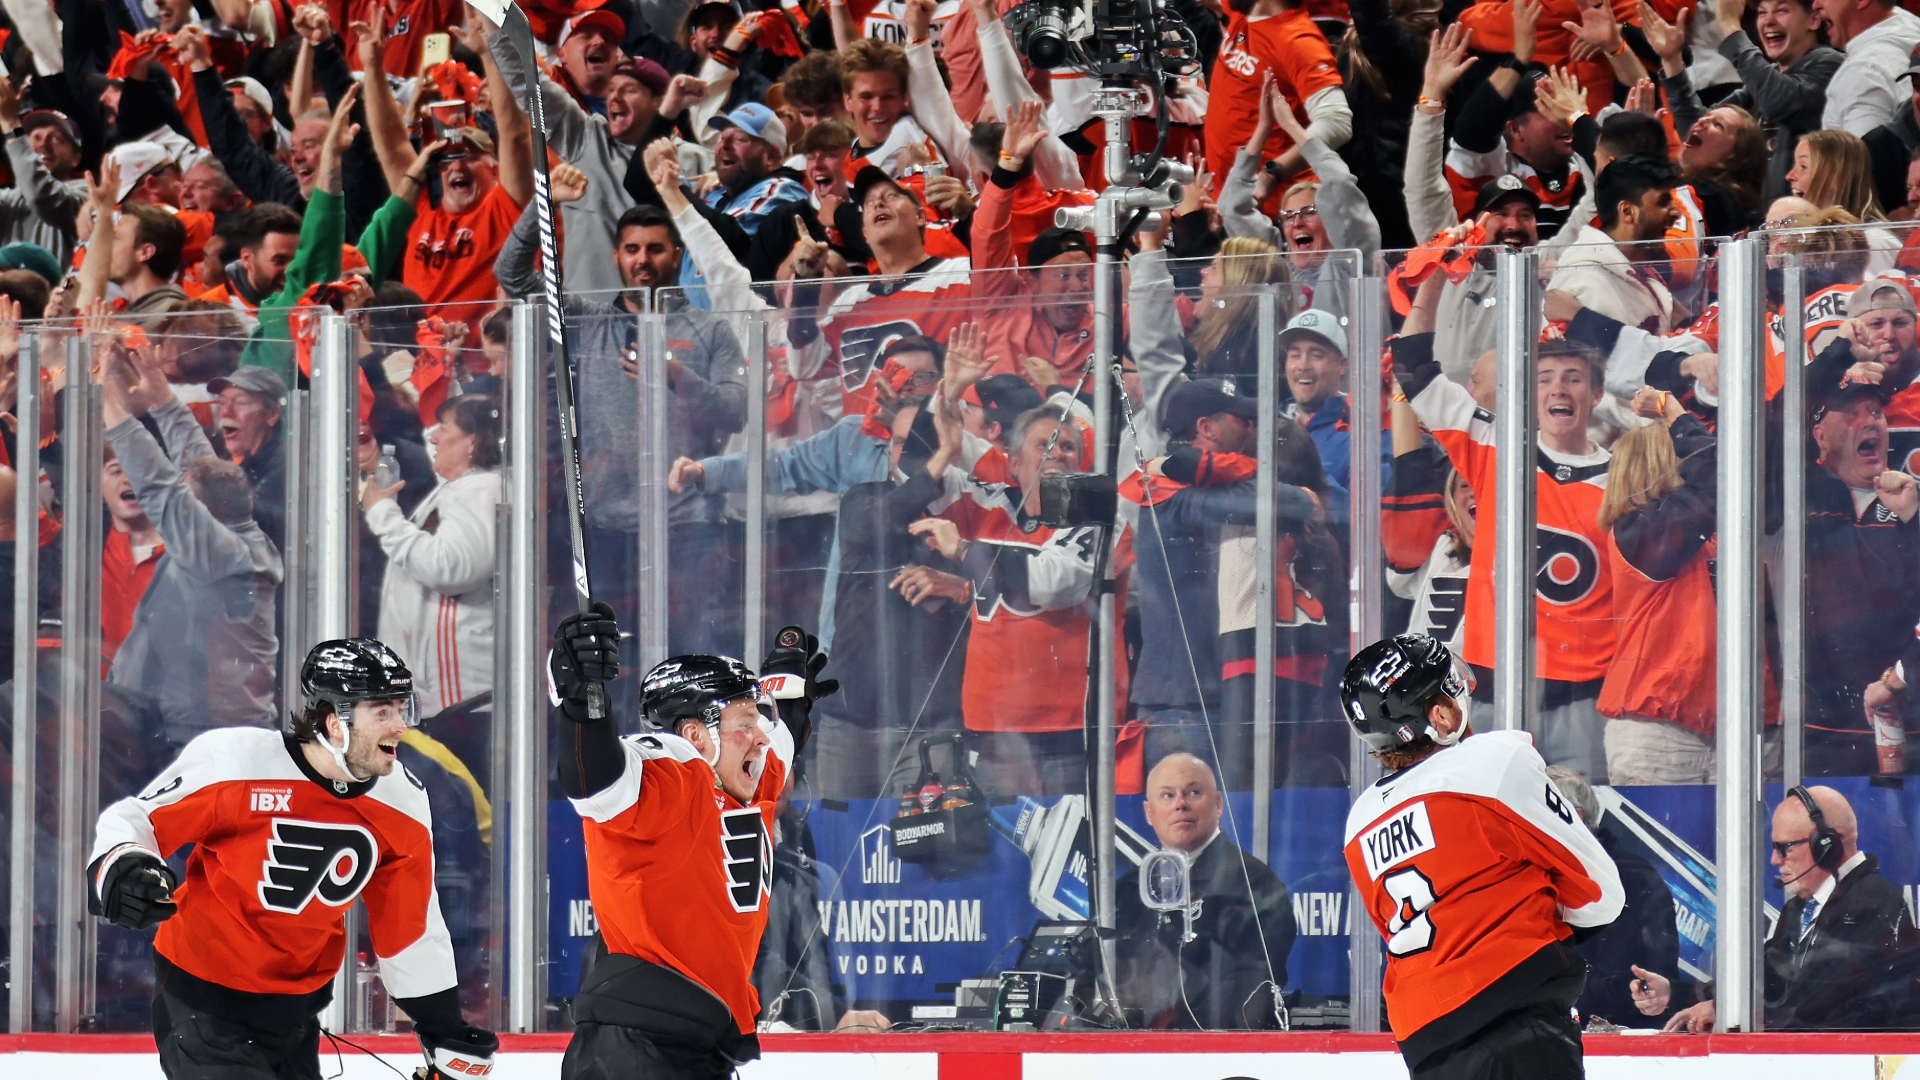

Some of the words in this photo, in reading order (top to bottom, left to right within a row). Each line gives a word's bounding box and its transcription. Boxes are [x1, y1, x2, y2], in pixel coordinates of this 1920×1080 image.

[533, 168, 563, 345] WARRIOR
[1379, 661, 1412, 693] CHEVROLET
[1351, 700, 1366, 721] 8
[251, 794, 292, 811] IBX
[1546, 784, 1574, 824] 8
[896, 822, 945, 841] BODYARMOR
[1016, 809, 1032, 836] VODKA
[1367, 811, 1424, 871] YORK
[1069, 851, 1088, 886] NE
[835, 899, 980, 942] AMSTERDAM
[1293, 893, 1341, 936] NEW
[1384, 865, 1440, 958] 8
[839, 954, 924, 974] VODKA
